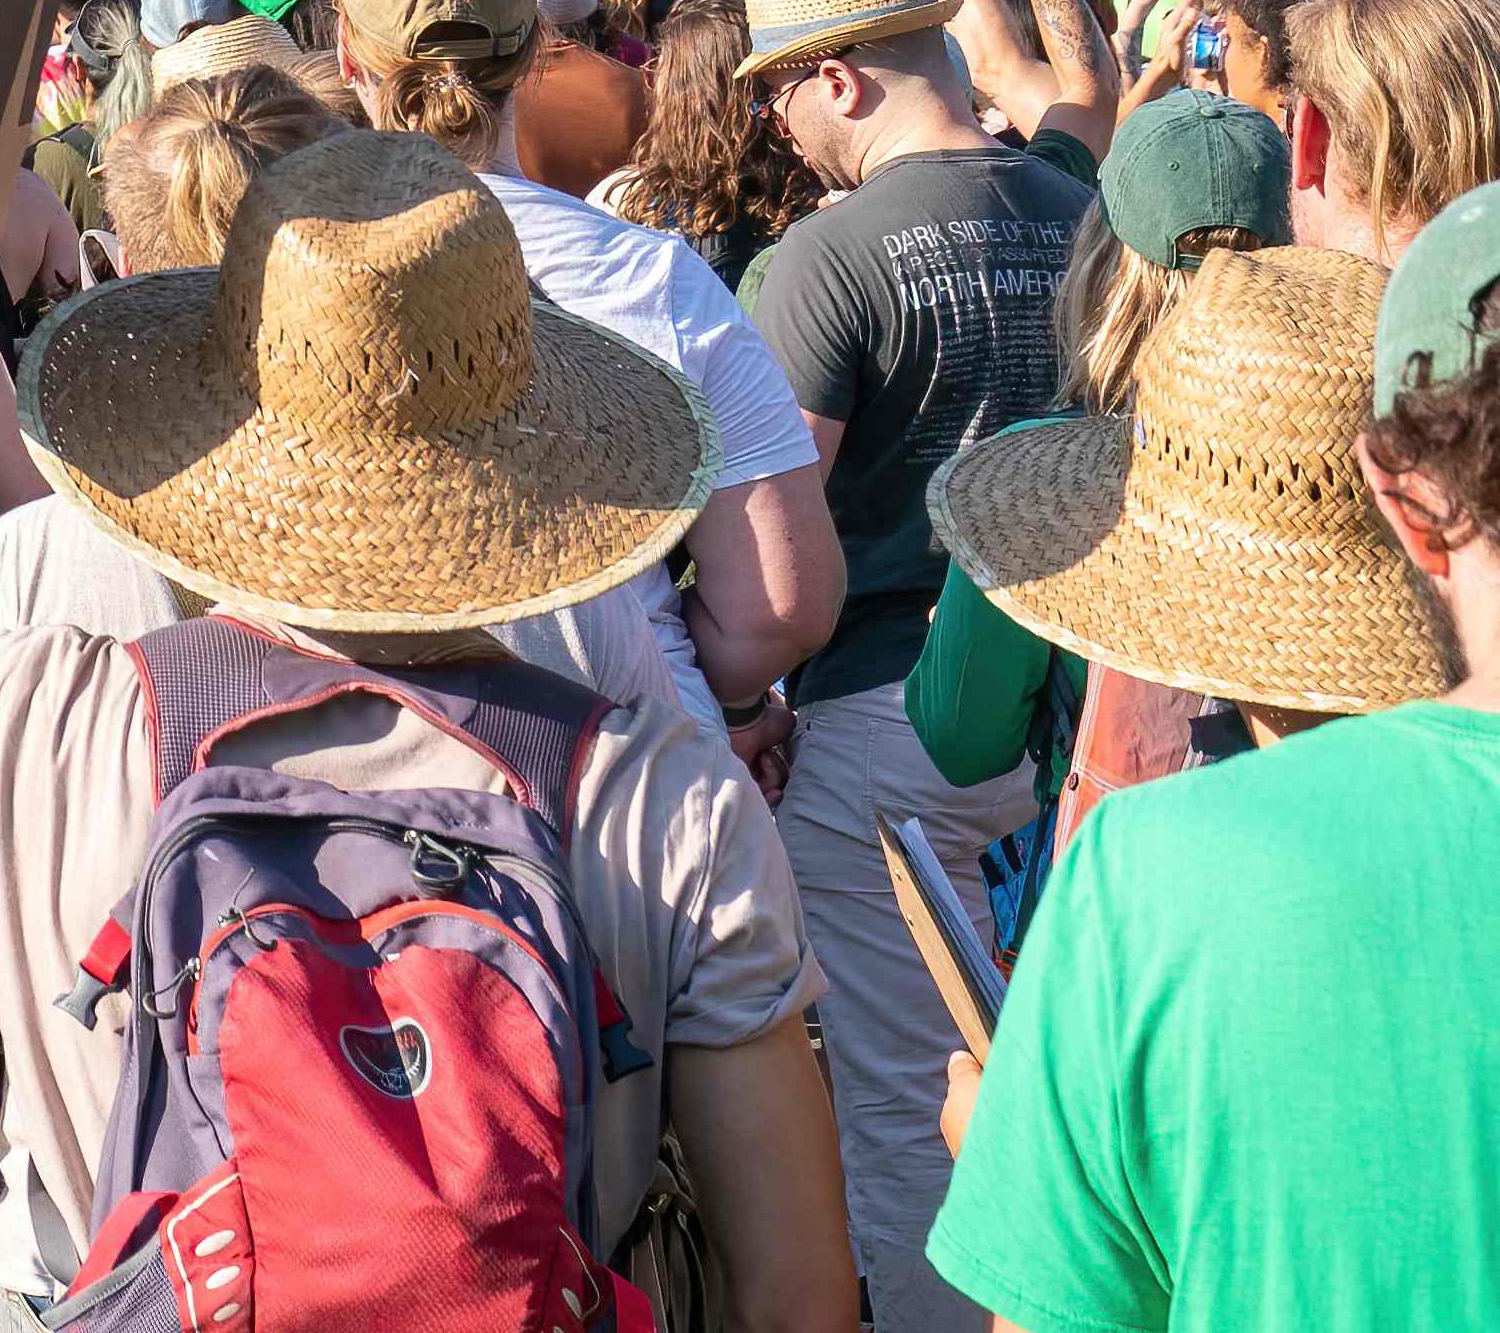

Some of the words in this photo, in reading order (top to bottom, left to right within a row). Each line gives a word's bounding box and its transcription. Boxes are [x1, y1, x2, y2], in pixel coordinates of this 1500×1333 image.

[883, 222, 949, 259] DARK
[948, 220, 1002, 244] SIDE
[1002, 221, 1024, 242] OF
[1029, 222, 1069, 244] THE
[900, 270, 988, 312] NORTH
